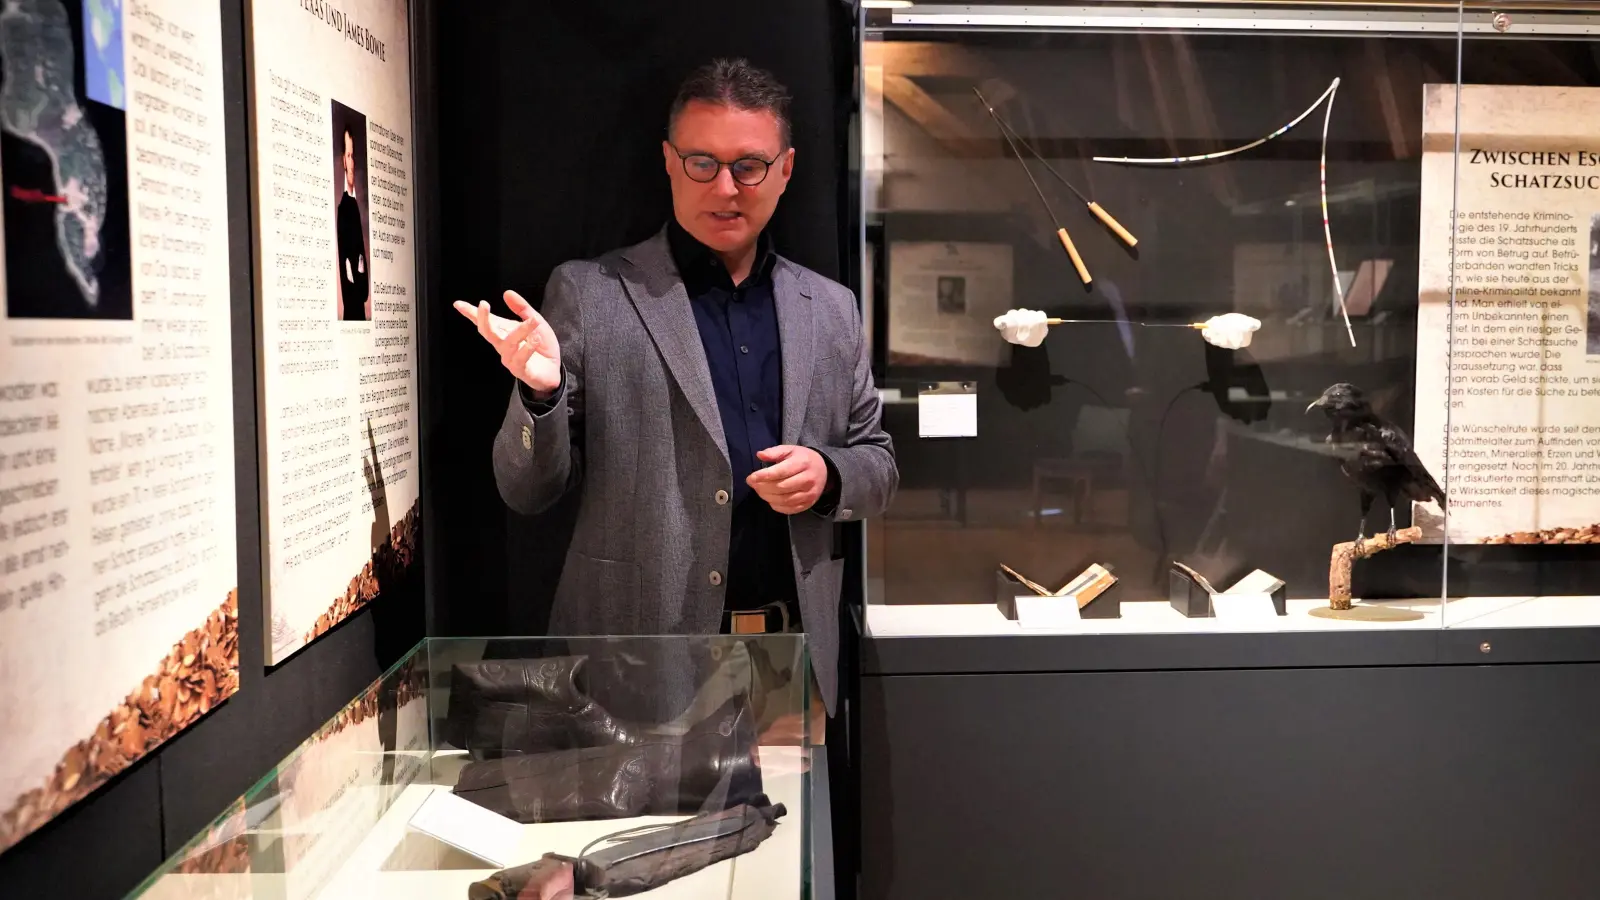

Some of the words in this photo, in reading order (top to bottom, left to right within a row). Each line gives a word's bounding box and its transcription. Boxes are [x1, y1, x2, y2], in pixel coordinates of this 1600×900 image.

[300, 0, 323, 19] EXAS
[325, 2, 342, 31] UND
[343, 12, 364, 47] JAMES
[365, 28, 385, 62] BOWIE
[1470, 149, 1569, 166] ZWISCHEN
[1578, 151, 1600, 166] ES
[1490, 172, 1599, 189] SCHATZSUC
[1468, 211, 1530, 220] entstehende
[1533, 211, 1573, 220] Krimino-
[1449, 222, 1475, 234] lgie
[1477, 223, 1494, 232] des
[1499, 223, 1510, 232] 19.
[1514, 223, 1577, 233] Jahrhunderts
[1479, 235, 1495, 245] die
[1498, 236, 1558, 245] Schatzsuche
[1562, 236, 1575, 246] als
[1498, 248, 1528, 260] Betrug
[1553, 249, 1579, 258] Betrü-
[1507, 261, 1550, 271] wandten
[1553, 262, 1578, 271] Tricks
[1466, 273, 1482, 282] wie
[1486, 273, 1499, 283] sie
[1502, 274, 1530, 283] heute
[1553, 274, 1569, 283] der
[1540, 286, 1580, 296] bekannt
[1472, 298, 1494, 308] Man
[1497, 298, 1527, 308] erhielt
[1472, 311, 1537, 321] Unbekannten
[1541, 311, 1568, 321] einen
[1472, 323, 1480, 333] In
[1483, 323, 1505, 333] dem
[1509, 323, 1523, 333] ein
[1527, 324, 1562, 335] riesiger
[1565, 324, 1582, 333] Ge-
[1472, 336, 1487, 345] bei
[1491, 336, 1515, 346] einer
[1518, 336, 1578, 346] Schatzsuche
[1446, 349, 1507, 361] versprochen
[1545, 349, 1560, 358] Die
[1540, 361, 1562, 371] dass
[1471, 374, 1500, 383] vorab
[1503, 374, 1526, 383] Geld
[1529, 374, 1569, 385] schickte,
[1574, 376, 1589, 384] um
[1467, 386, 1499, 396] Kosten
[1502, 386, 1515, 396] für
[1518, 386, 1532, 396] die
[1536, 386, 1565, 396] Suche
[1568, 388, 1578, 396] zu
[1462, 424, 1527, 433] Wünschelrute
[1530, 424, 1560, 433] wurde
[1564, 424, 1580, 433] seit
[1538, 436, 1583, 445] Auffinden
[1442, 448, 1488, 459] Shätzen,
[1548, 449, 1572, 458] Erzen
[1575, 449, 1593, 458] und
[1512, 461, 1538, 470] Noch
[1541, 461, 1553, 470] im
[1556, 461, 1568, 470] 20.
[1464, 473, 1513, 482] diskutierte
[1516, 475, 1538, 483] man
[1541, 473, 1583, 483] ernsthaft
[1459, 485, 1516, 495] Wirksamkeit
[1519, 486, 1549, 495] dieses
